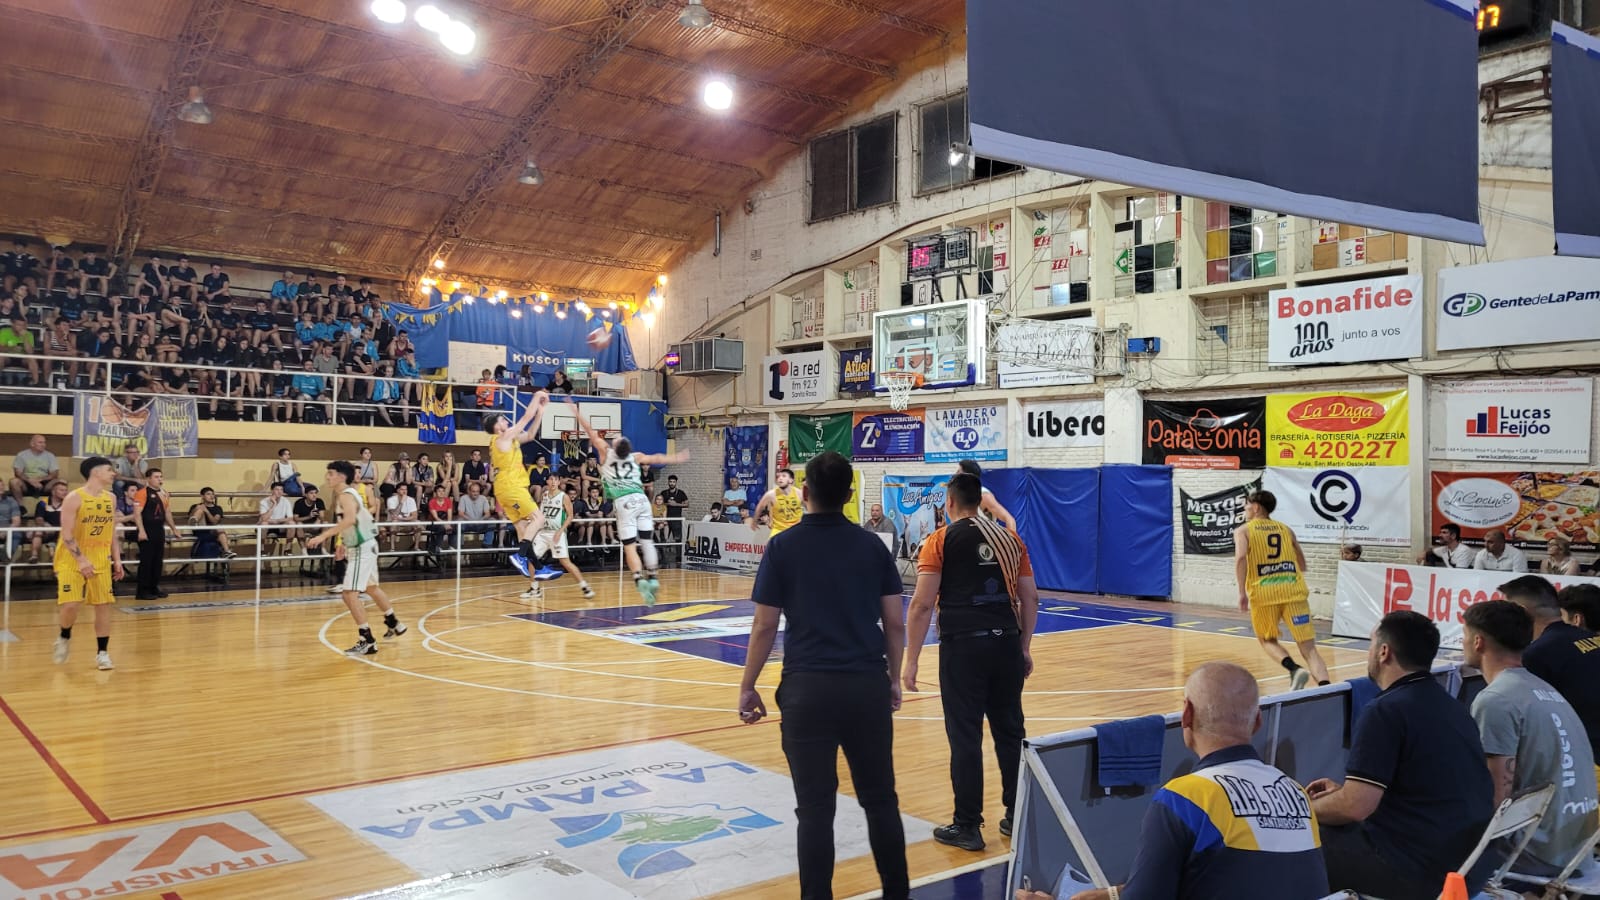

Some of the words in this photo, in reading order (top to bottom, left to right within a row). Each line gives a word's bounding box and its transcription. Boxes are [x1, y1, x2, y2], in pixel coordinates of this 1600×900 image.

[1277, 284, 1413, 319] Bonafide
[1490, 290, 1600, 309] GentedeLaPam
[1294, 321, 1329, 345] 100
[1341, 330, 1368, 342] junto
[1371, 330, 1378, 338] a
[1381, 327, 1401, 337] vos
[1289, 338, 1335, 358] años
[513, 353, 560, 366] KIOSCO
[790, 361, 799, 376] la
[802, 360, 820, 376] red
[845, 358, 871, 374] Atuel
[802, 379, 818, 390] 92.9
[936, 407, 997, 421] LAVADERO
[1300, 403, 1322, 418] La
[1328, 402, 1373, 424] Daga
[1500, 405, 1551, 419] Lucas
[945, 417, 990, 428] INDUSTRIAL
[1500, 421, 1551, 437] Feijóo
[1270, 433, 1310, 441] BRASERÍA
[1316, 432, 1360, 441] ROTISERÍA
[1367, 430, 1406, 440] PIZZERÍA
[1303, 441, 1397, 459] 420227
[610, 461, 633, 479] 12
[90, 526, 104, 536] 20
[725, 542, 752, 554] EMPRESA
[1267, 533, 1282, 559] 9
[1428, 573, 1453, 623] la
[559, 761, 688, 786] Gobierno
[657, 761, 758, 784] LA
[516, 783, 552, 795] en
[359, 779, 651, 839] PAMPA
[396, 790, 505, 815] Acción
